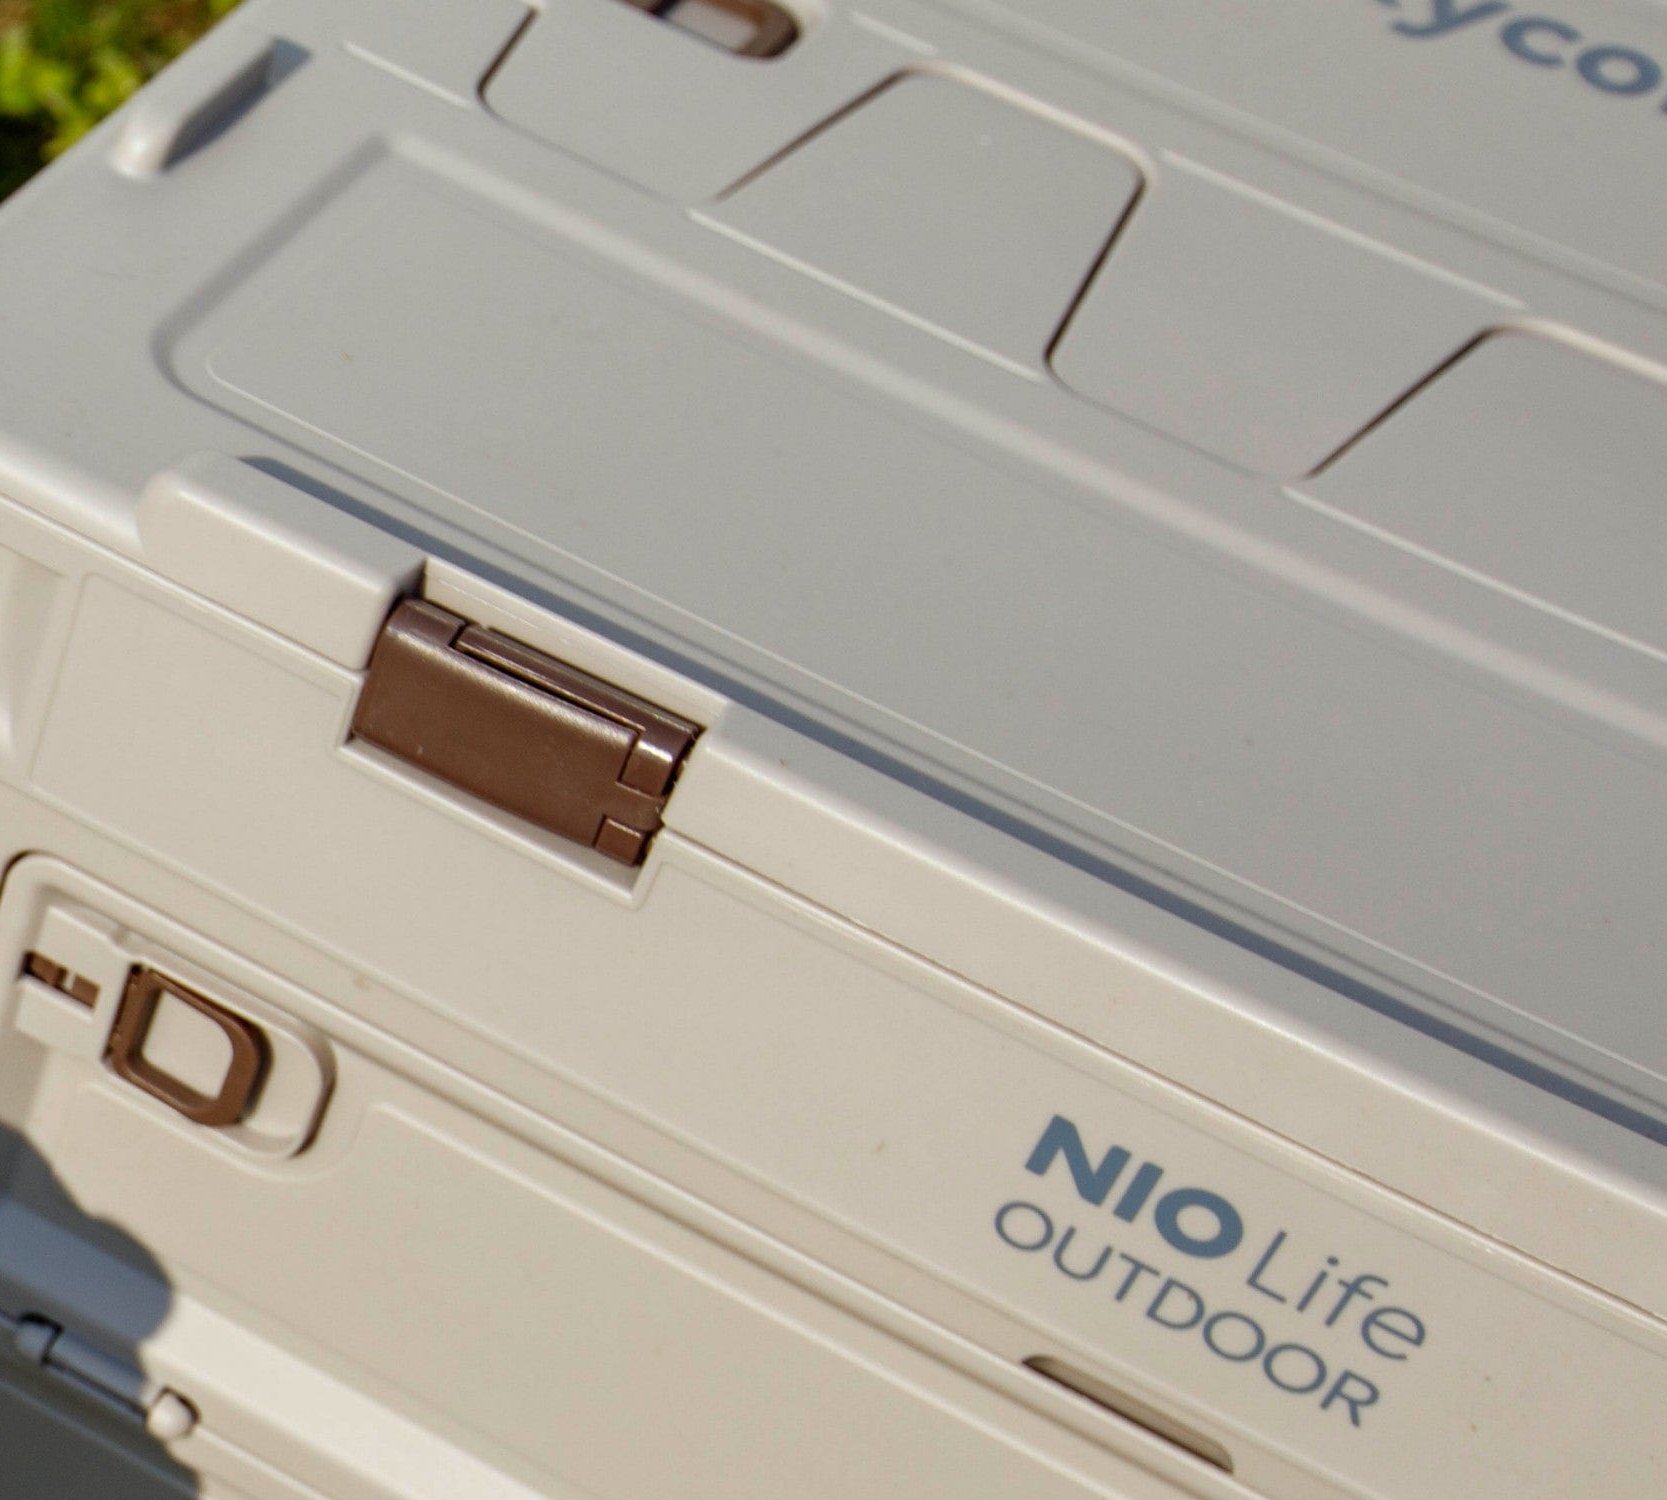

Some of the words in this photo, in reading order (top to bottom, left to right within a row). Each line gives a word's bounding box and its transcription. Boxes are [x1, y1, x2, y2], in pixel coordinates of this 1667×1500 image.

[993, 1200, 1381, 1429] OUTDOOR
[1024, 1113, 1244, 1260] NIO
[1245, 1229, 1427, 1362] Life
